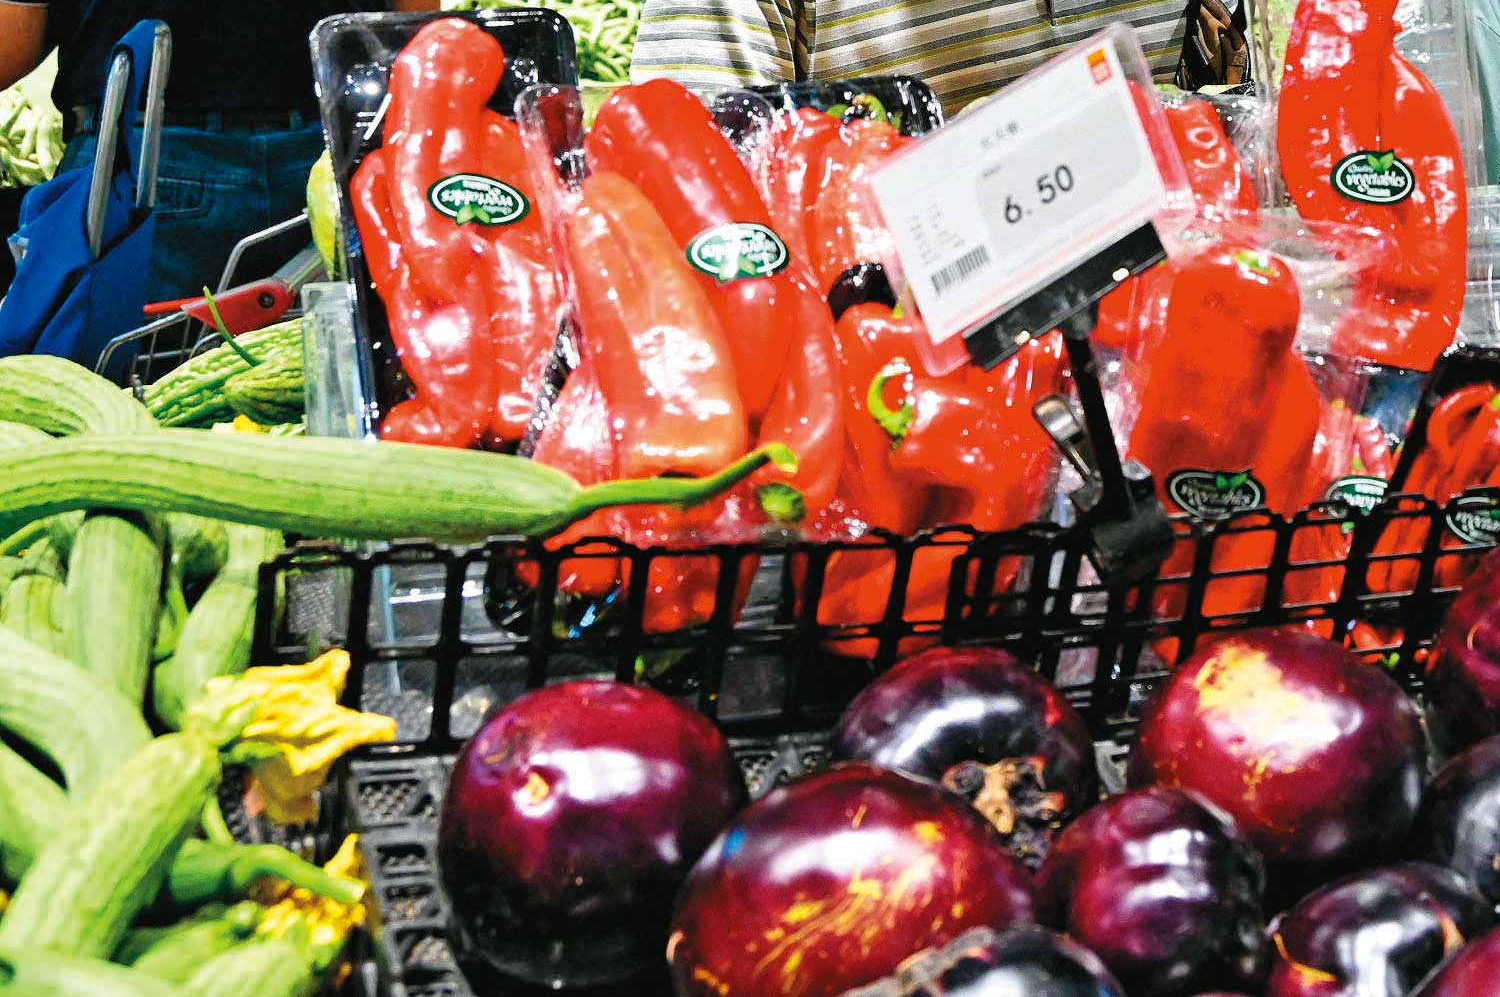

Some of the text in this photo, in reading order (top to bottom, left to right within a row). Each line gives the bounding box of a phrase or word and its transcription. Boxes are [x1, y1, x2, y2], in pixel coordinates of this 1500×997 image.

[1345, 170, 1406, 193] vegetables
[441, 187, 513, 206] vegetables
[1005, 165, 1074, 224] 6.50
